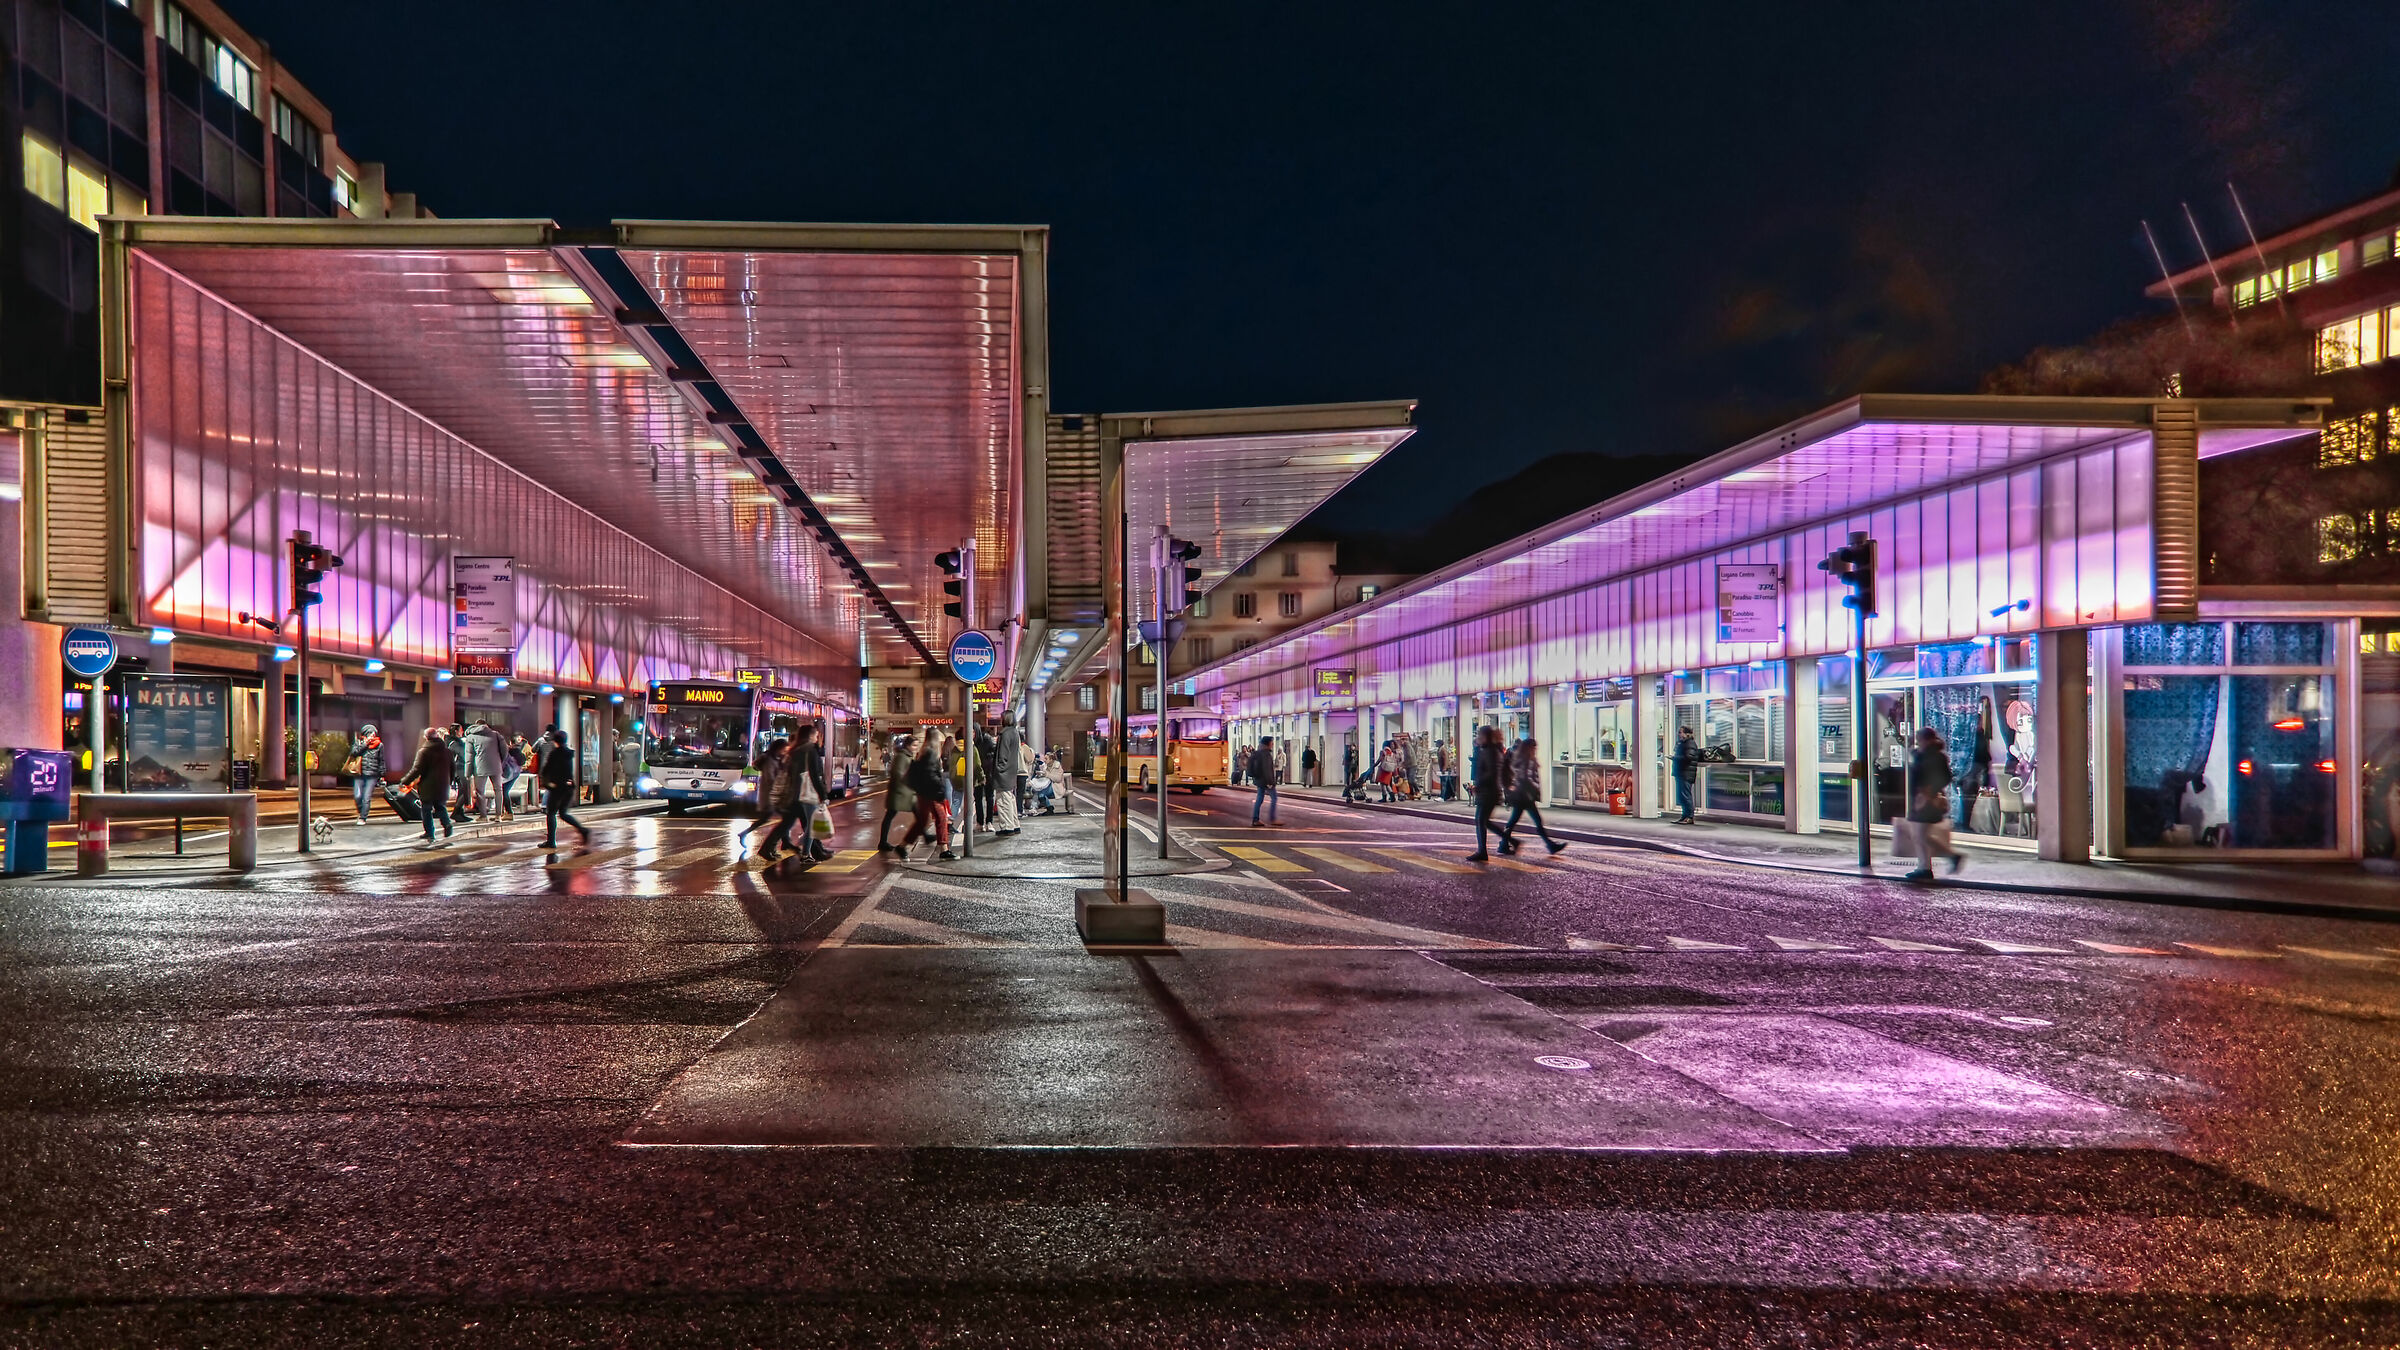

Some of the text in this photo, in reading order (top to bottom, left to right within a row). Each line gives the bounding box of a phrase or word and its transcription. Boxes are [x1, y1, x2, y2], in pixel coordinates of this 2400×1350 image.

[1721, 571, 1738, 579] Lugano
[1758, 583, 1776, 591] TPL
[477, 656, 493, 664] Bus
[460, 665, 510, 674] in Partenza
[138, 690, 216, 707] NATALE
[658, 687, 724, 703] 5 MANNO
[1821, 725, 1843, 737] TPL
[30, 760, 58, 785] 20
[702, 770, 721, 778] TPL
[1761, 799, 1782, 813] città
